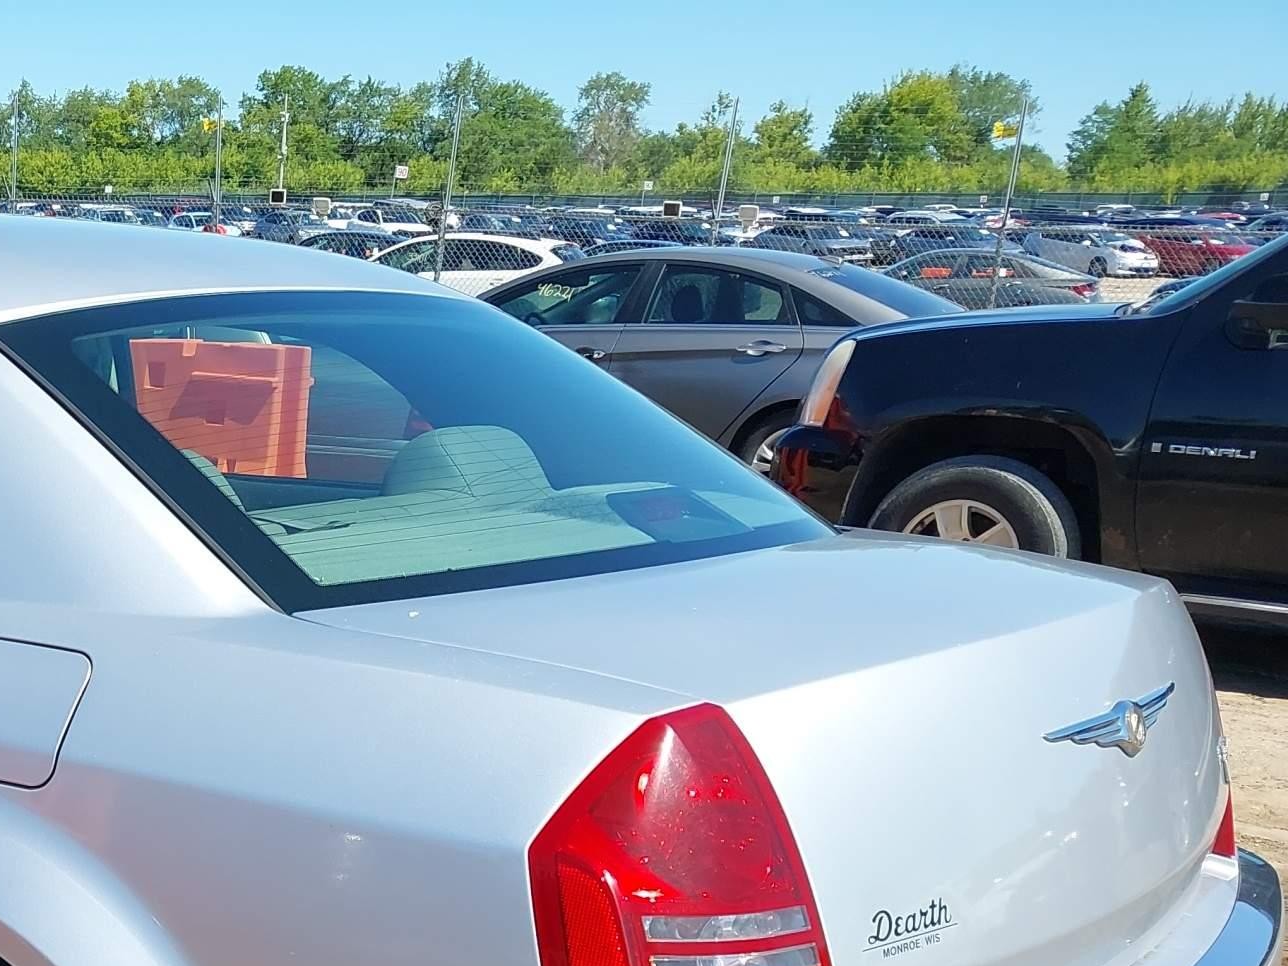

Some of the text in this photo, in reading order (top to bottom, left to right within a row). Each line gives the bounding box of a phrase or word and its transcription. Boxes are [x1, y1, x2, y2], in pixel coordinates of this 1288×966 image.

[1168, 444, 1257, 460] DENALI
[868, 897, 952, 945] Dearth
[882, 933, 941, 958] MONROE WIS
